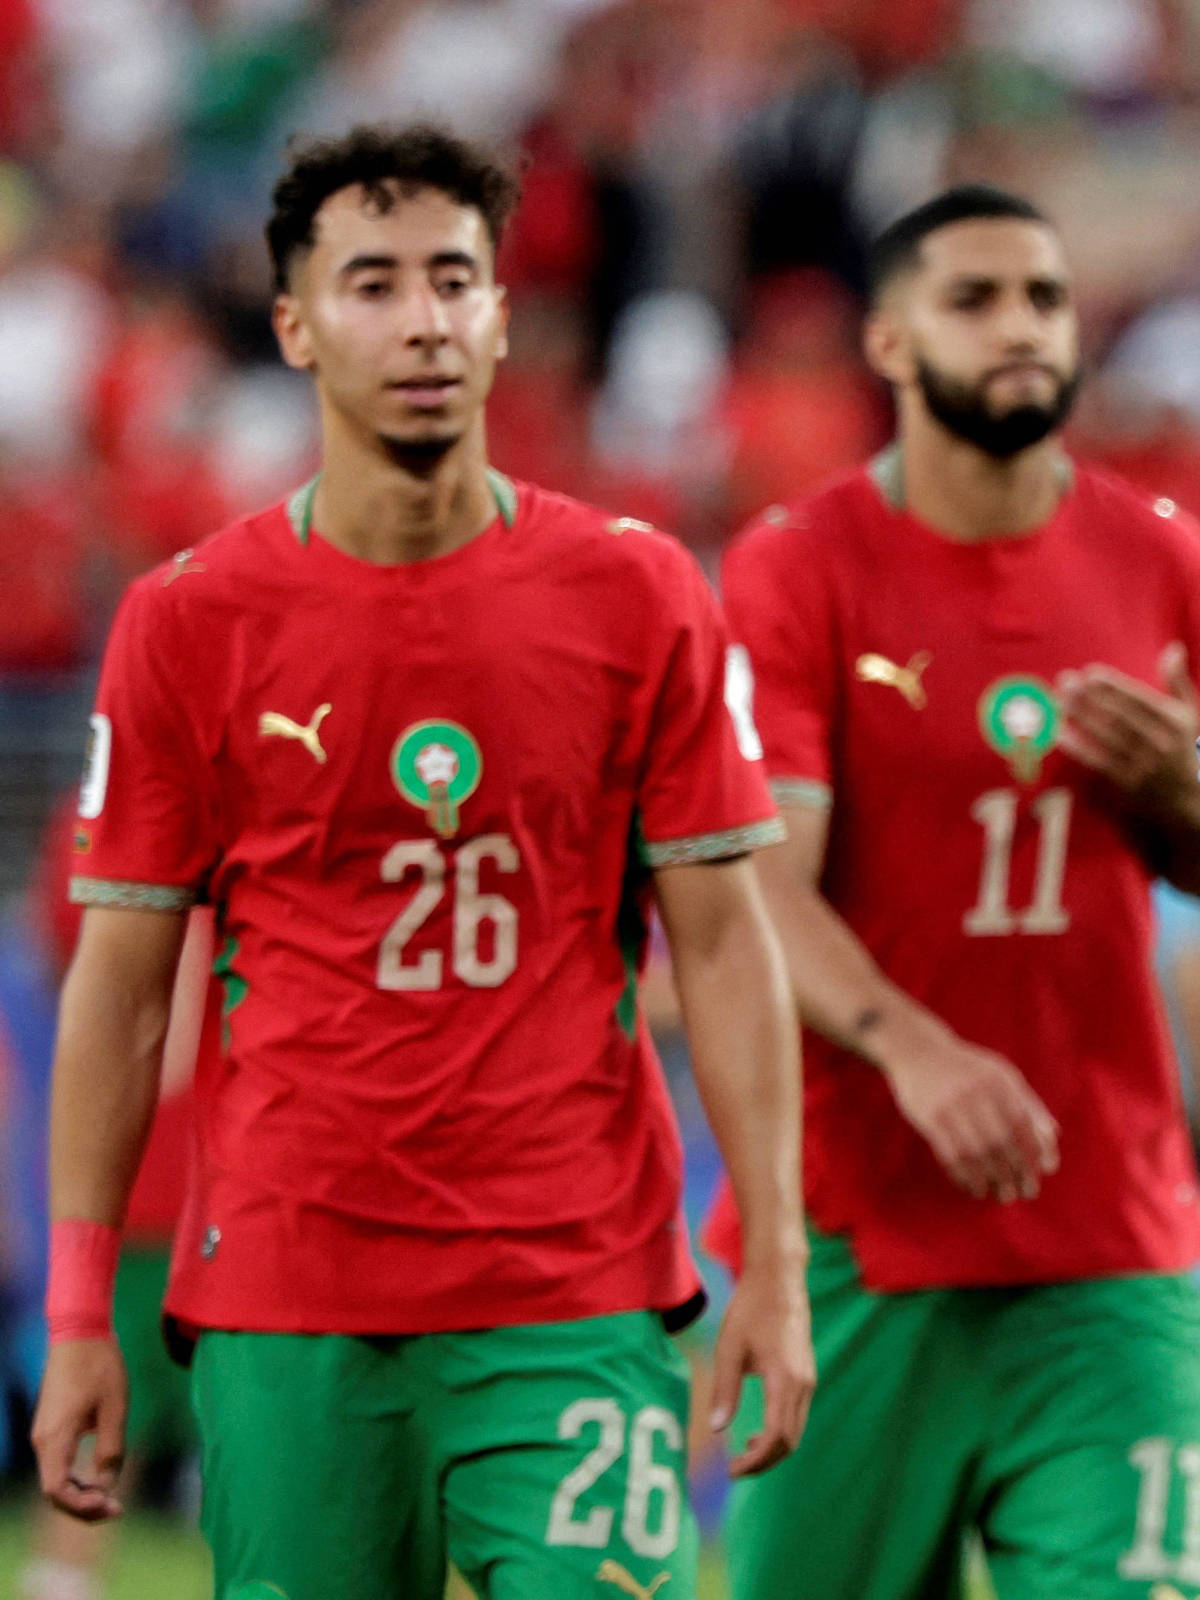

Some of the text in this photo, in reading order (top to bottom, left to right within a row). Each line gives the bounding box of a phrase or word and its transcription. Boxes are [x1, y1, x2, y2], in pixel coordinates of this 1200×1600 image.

[376, 833, 520, 991] 26
[962, 786, 1075, 937] 11
[545, 1397, 683, 1559] 26
